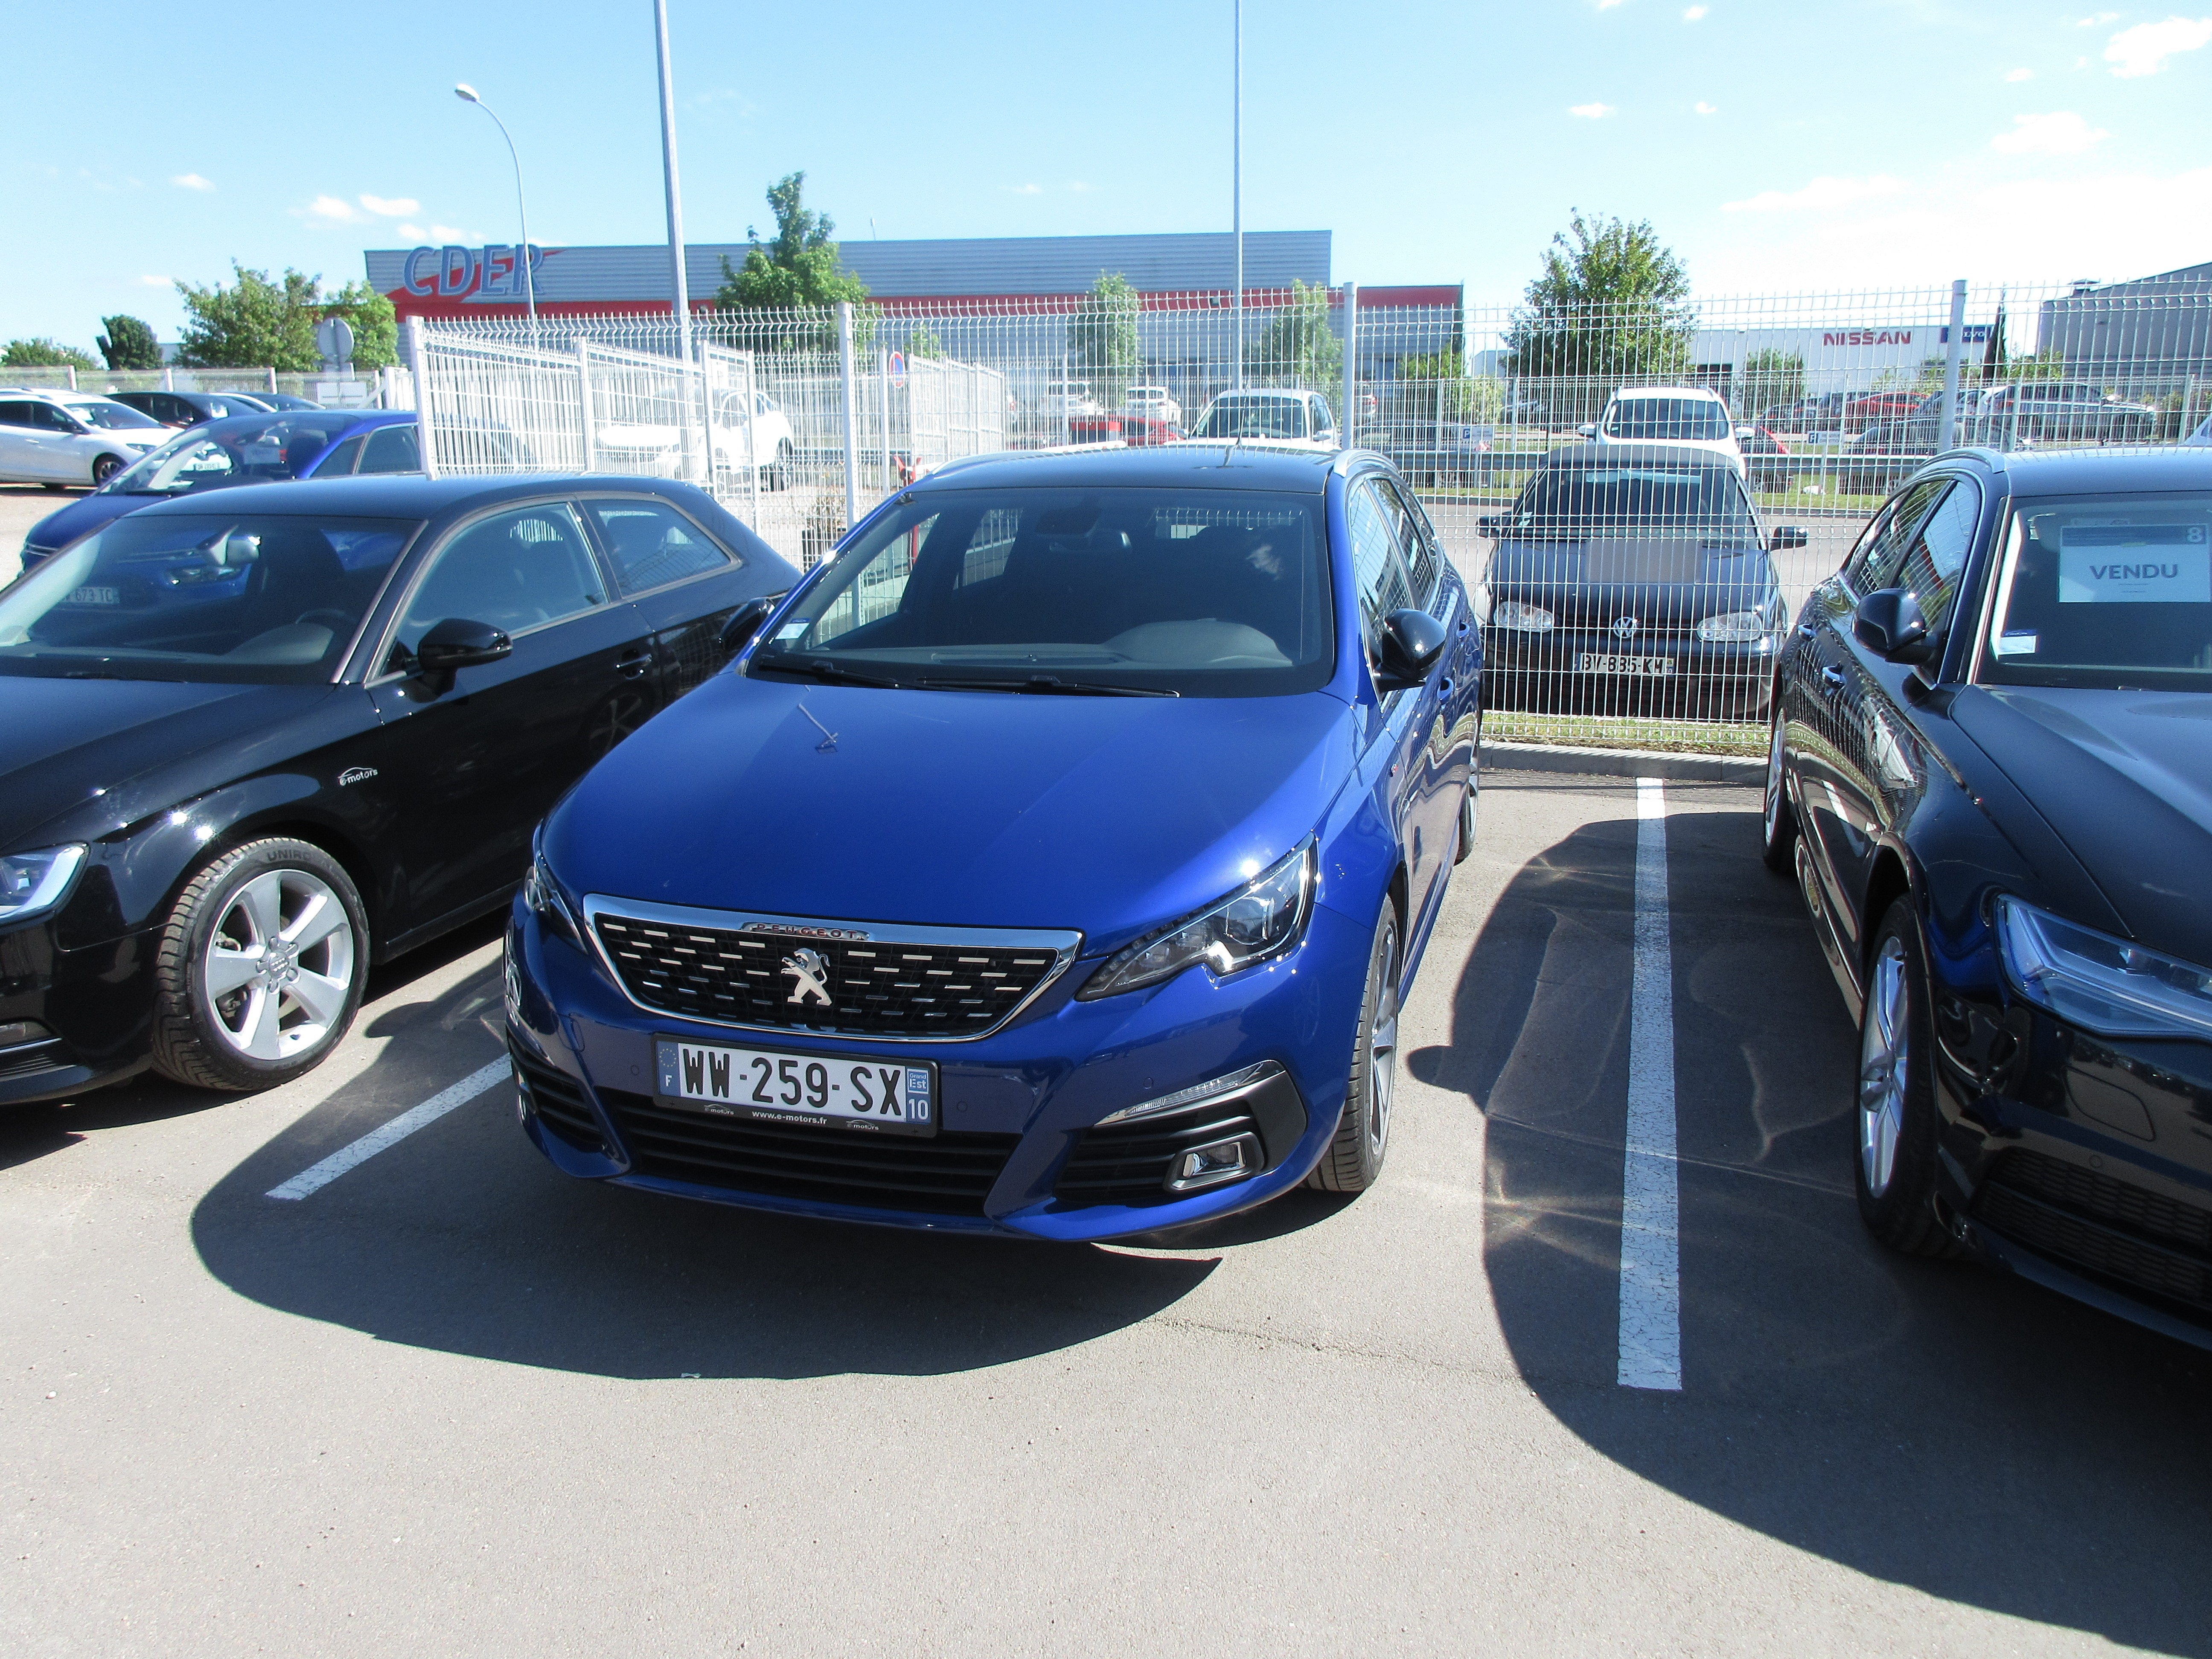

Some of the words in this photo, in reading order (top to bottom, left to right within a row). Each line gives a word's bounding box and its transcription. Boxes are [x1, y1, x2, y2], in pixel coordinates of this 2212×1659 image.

[404, 244, 545, 295] CDER
[1823, 331, 1911, 346] NISSAN
[2186, 527, 2202, 543] 8
[2090, 564, 2177, 579] VENDU
[340, 769, 378, 786] e-motors
[757, 923, 857, 938] PEUGEOT
[665, 1074, 672, 1087] F
[909, 1079, 927, 1089] Est
[908, 1098, 928, 1120] 10
[752, 1111, 827, 1124] www.e-motors.fr
